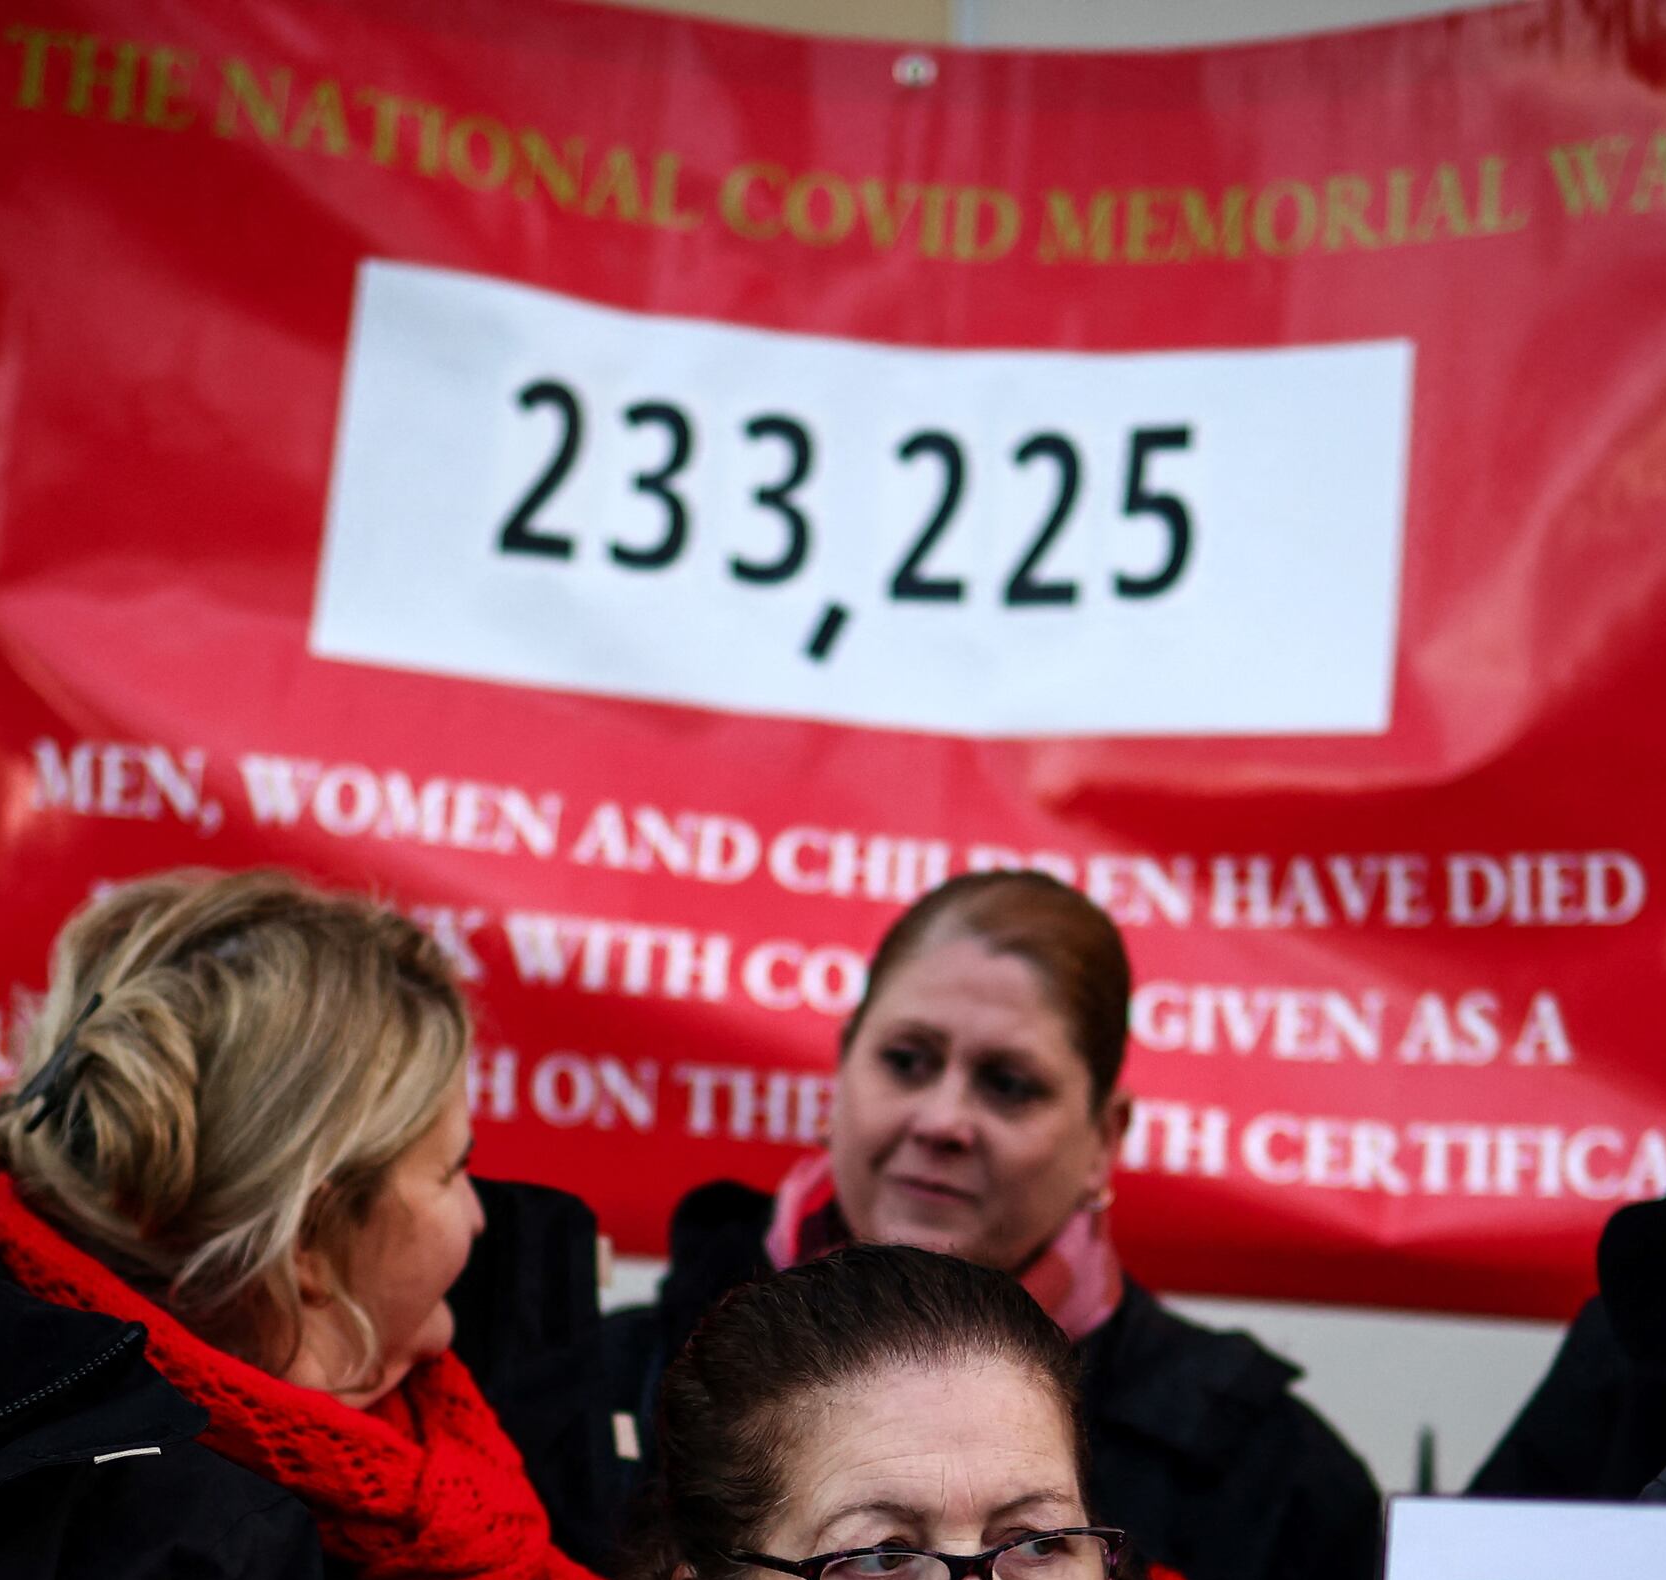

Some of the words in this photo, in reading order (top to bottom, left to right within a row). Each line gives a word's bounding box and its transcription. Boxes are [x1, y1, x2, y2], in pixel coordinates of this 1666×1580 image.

[3, 23, 196, 132] THE
[214, 55, 705, 234] NATIONAL
[720, 160, 1023, 266] COVID
[1036, 156, 1531, 267] MEMORIAL
[494, 378, 1197, 664] 233,225
[31, 735, 225, 837] MEN,
[237, 752, 566, 856] WOMEN
[572, 793, 762, 884] AND
[1206, 850, 1443, 932] HAVE
[1445, 848, 1647, 927] DIED
[500, 909, 733, 1003] WITH
[1127, 980, 1389, 1064] GIVEN
[1399, 992, 1503, 1068] AS
[1511, 990, 1574, 1066] A
[531, 1050, 661, 1132] ON
